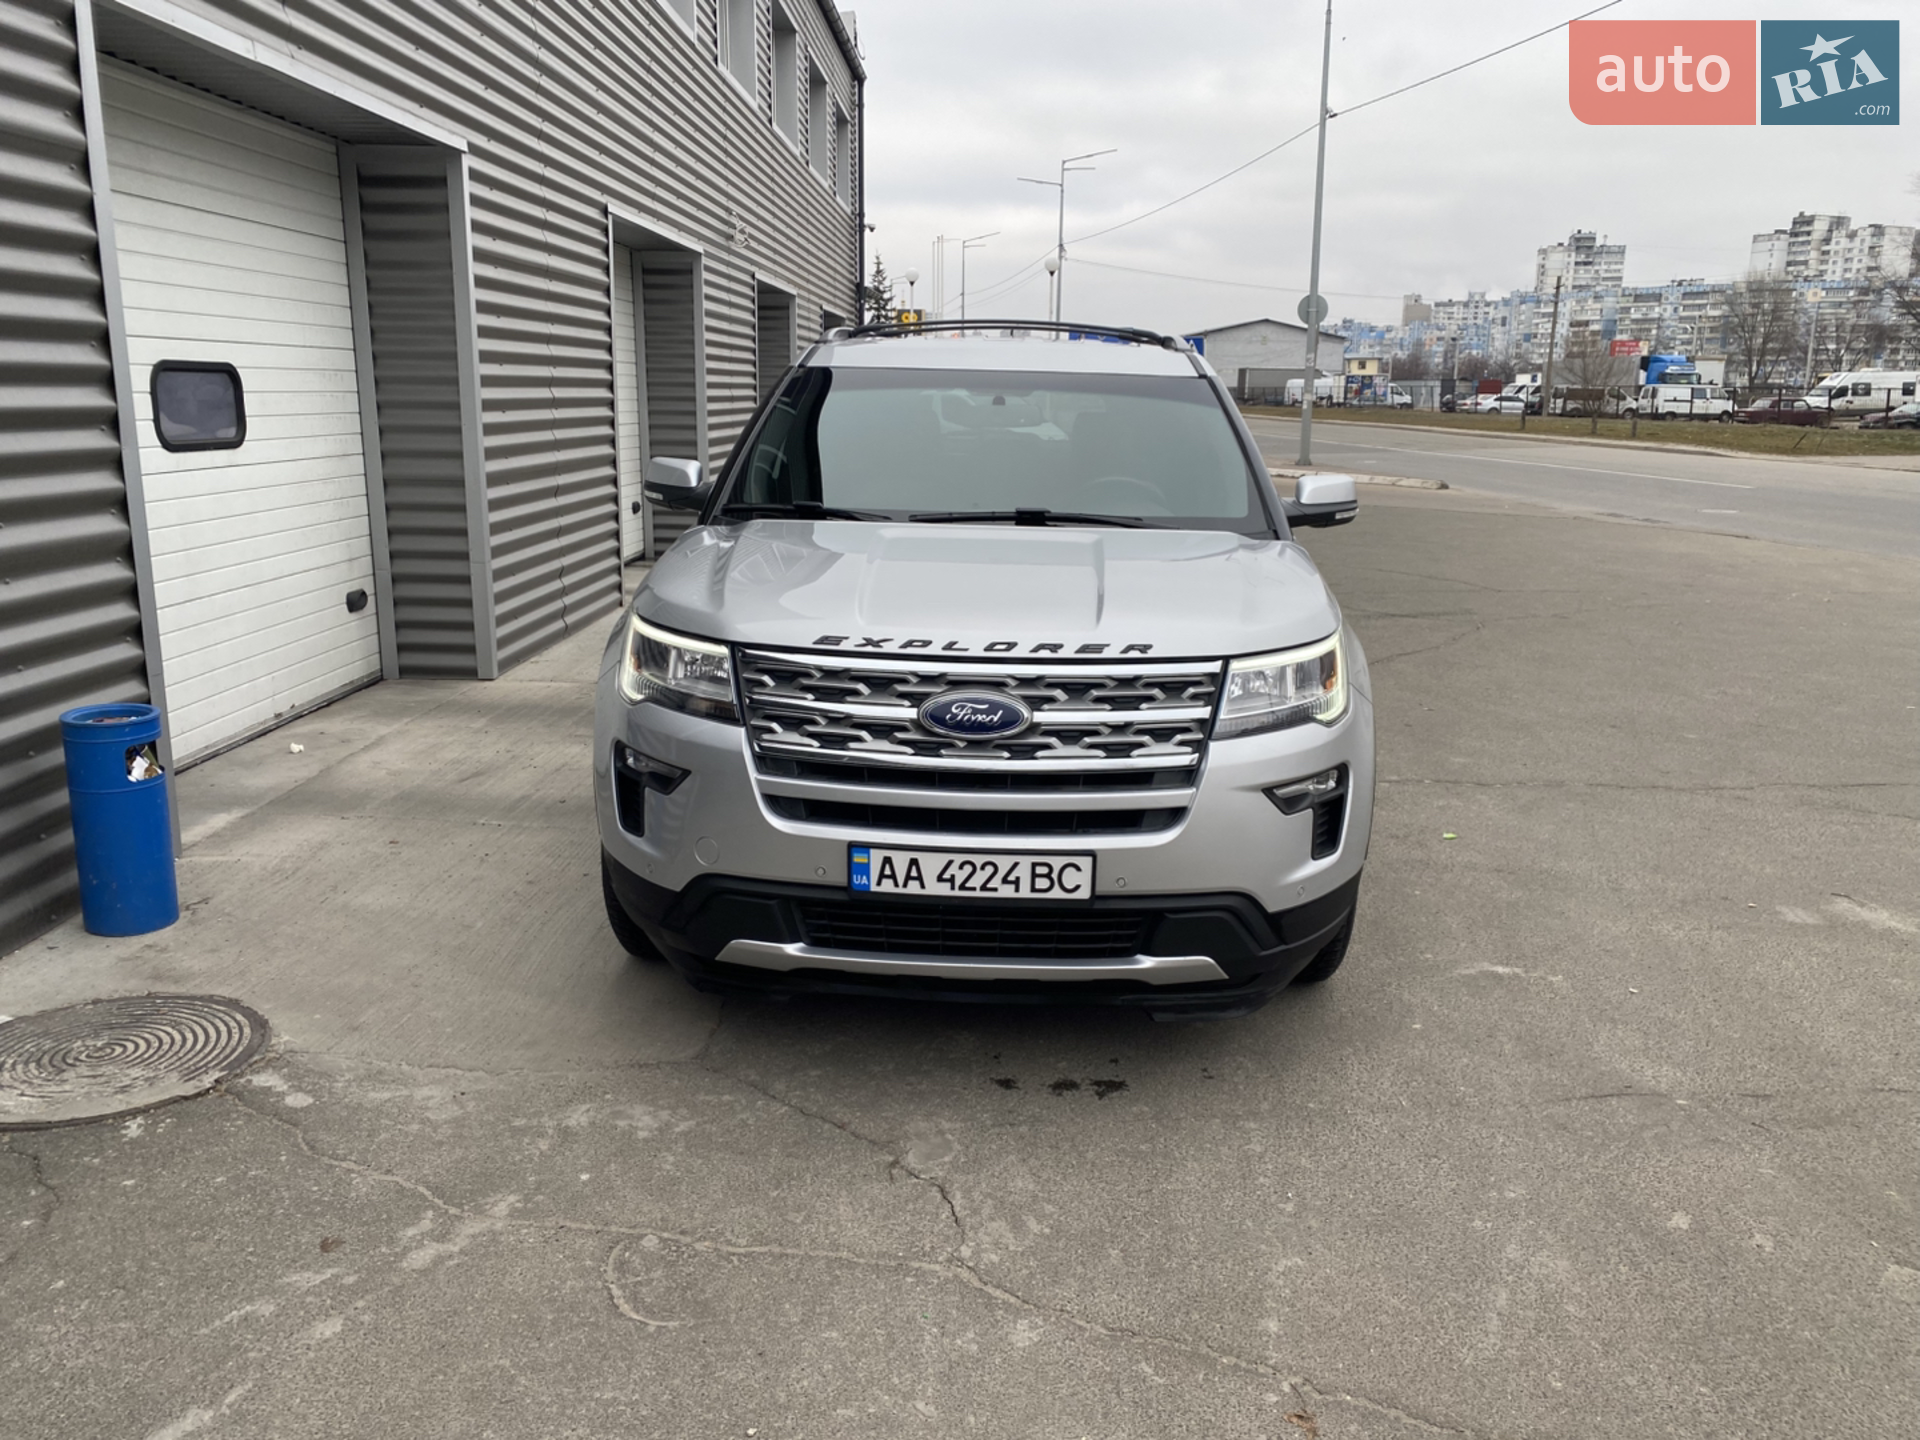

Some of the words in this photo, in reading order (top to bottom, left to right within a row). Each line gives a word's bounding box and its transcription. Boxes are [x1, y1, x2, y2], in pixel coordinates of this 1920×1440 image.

[812, 634, 1154, 654] EXPLORER
[945, 702, 1004, 725] Ford
[852, 874, 869, 885] UA
